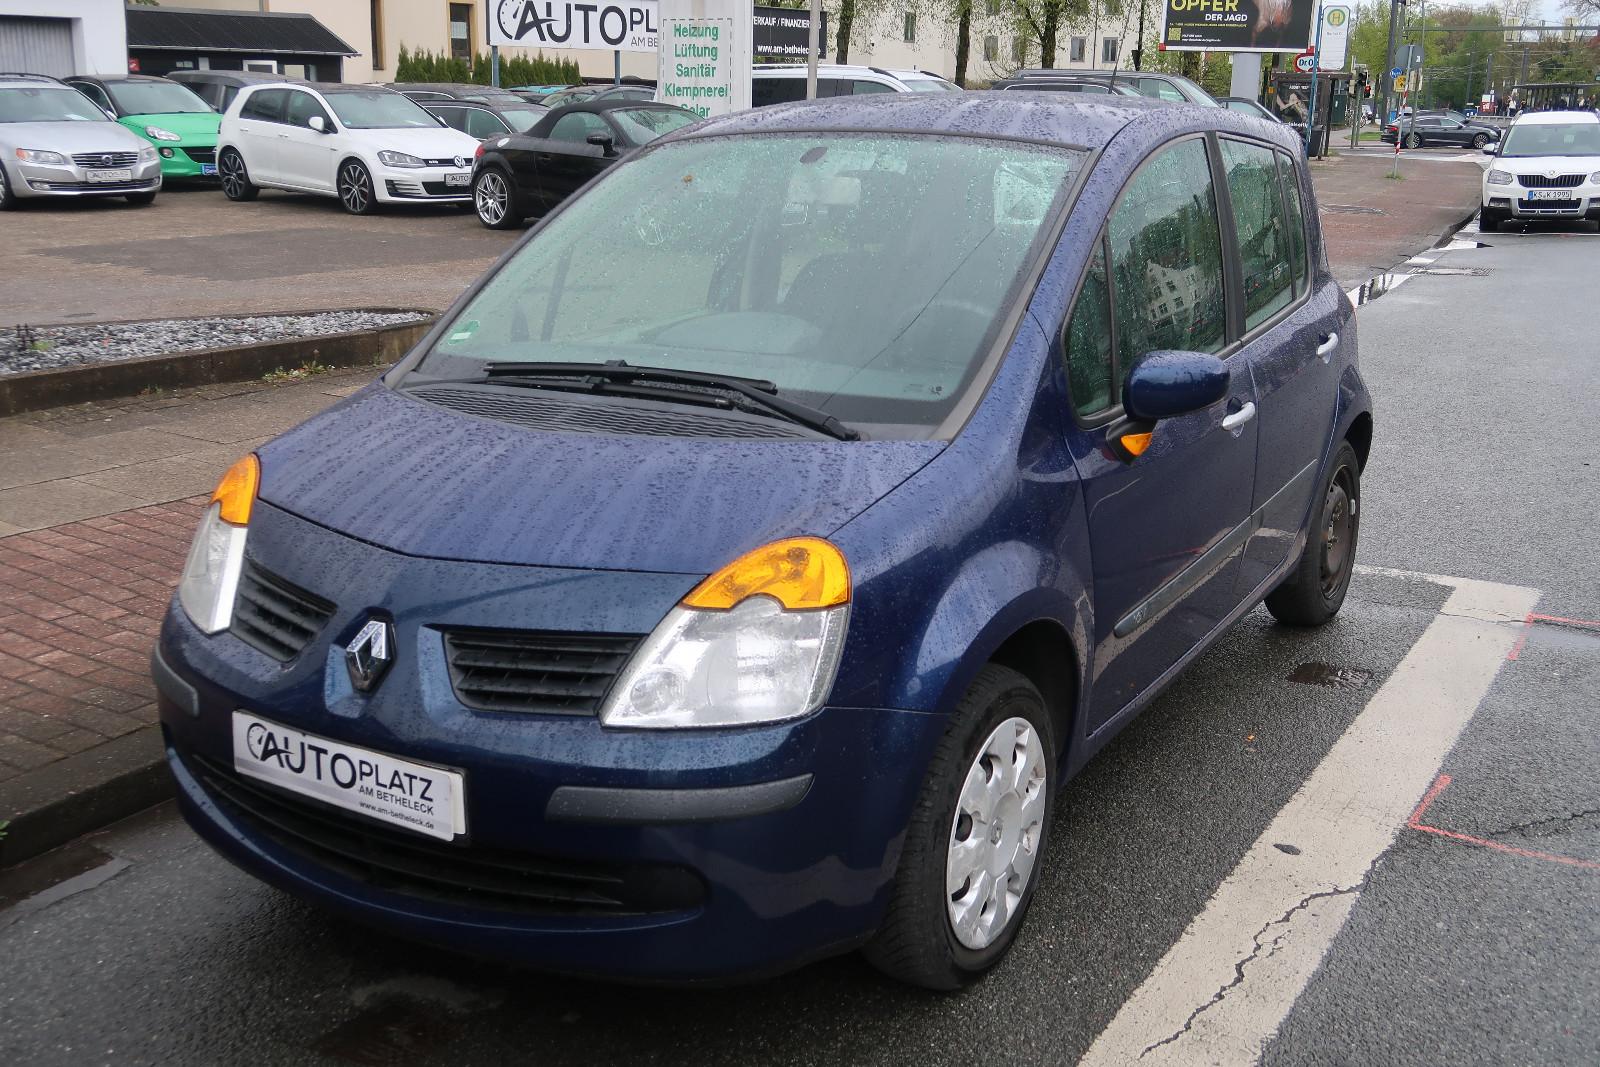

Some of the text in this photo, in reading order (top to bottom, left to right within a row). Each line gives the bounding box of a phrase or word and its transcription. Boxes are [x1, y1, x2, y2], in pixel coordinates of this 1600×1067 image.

[1171, 0, 1239, 11] OPFER
[674, 24, 719, 40] Heizung
[631, 37, 645, 47] AM
[674, 44, 718, 61] Lüftung
[676, 64, 716, 78] Sanitär
[665, 83, 728, 99] Klempnerei
[260, 732, 433, 802] AUTOPLATZ
[359, 785, 434, 816] AM BETHELECK
